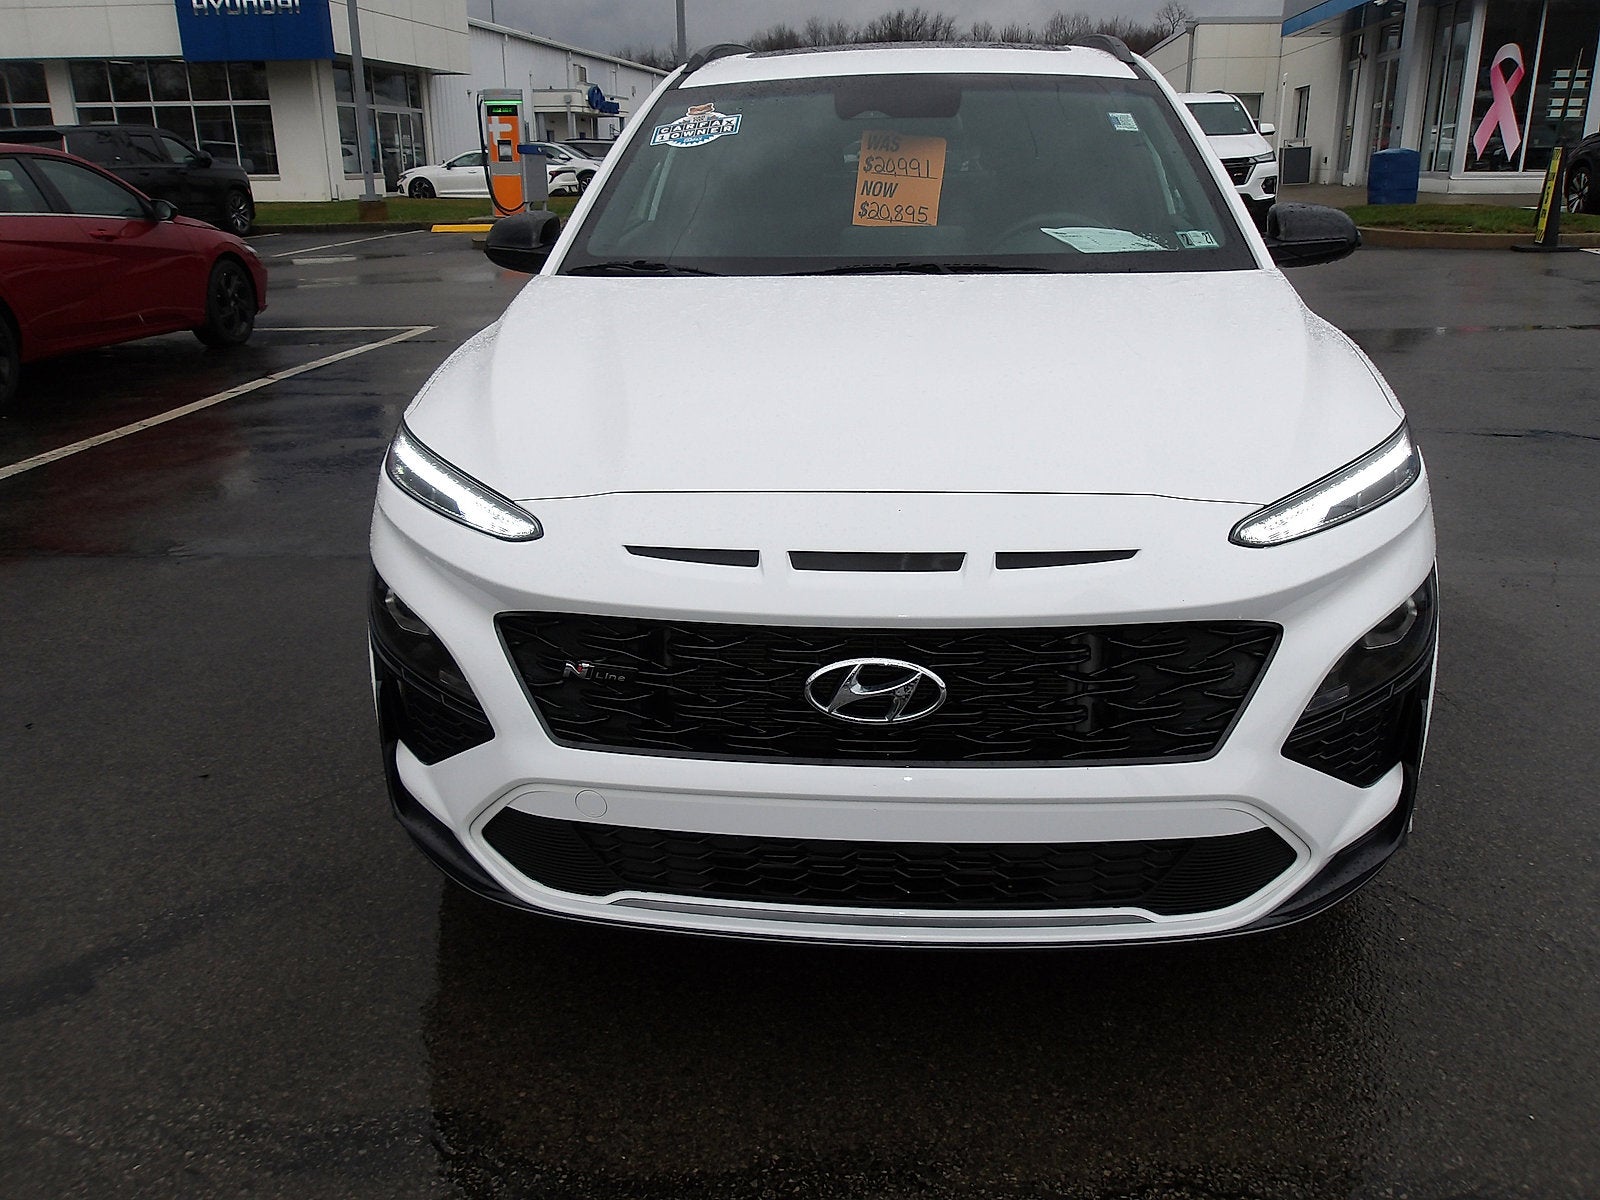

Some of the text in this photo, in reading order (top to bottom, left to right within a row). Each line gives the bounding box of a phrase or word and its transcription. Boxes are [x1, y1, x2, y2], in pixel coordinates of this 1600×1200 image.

[660, 119, 735, 134] CARFAX
[671, 125, 732, 139] OWNER
[866, 134, 902, 153] WAS
[863, 155, 930, 178] $20,991
[860, 180, 899, 198] NOW
[858, 201, 929, 223] $20,895
[595, 672, 626, 682] Line
